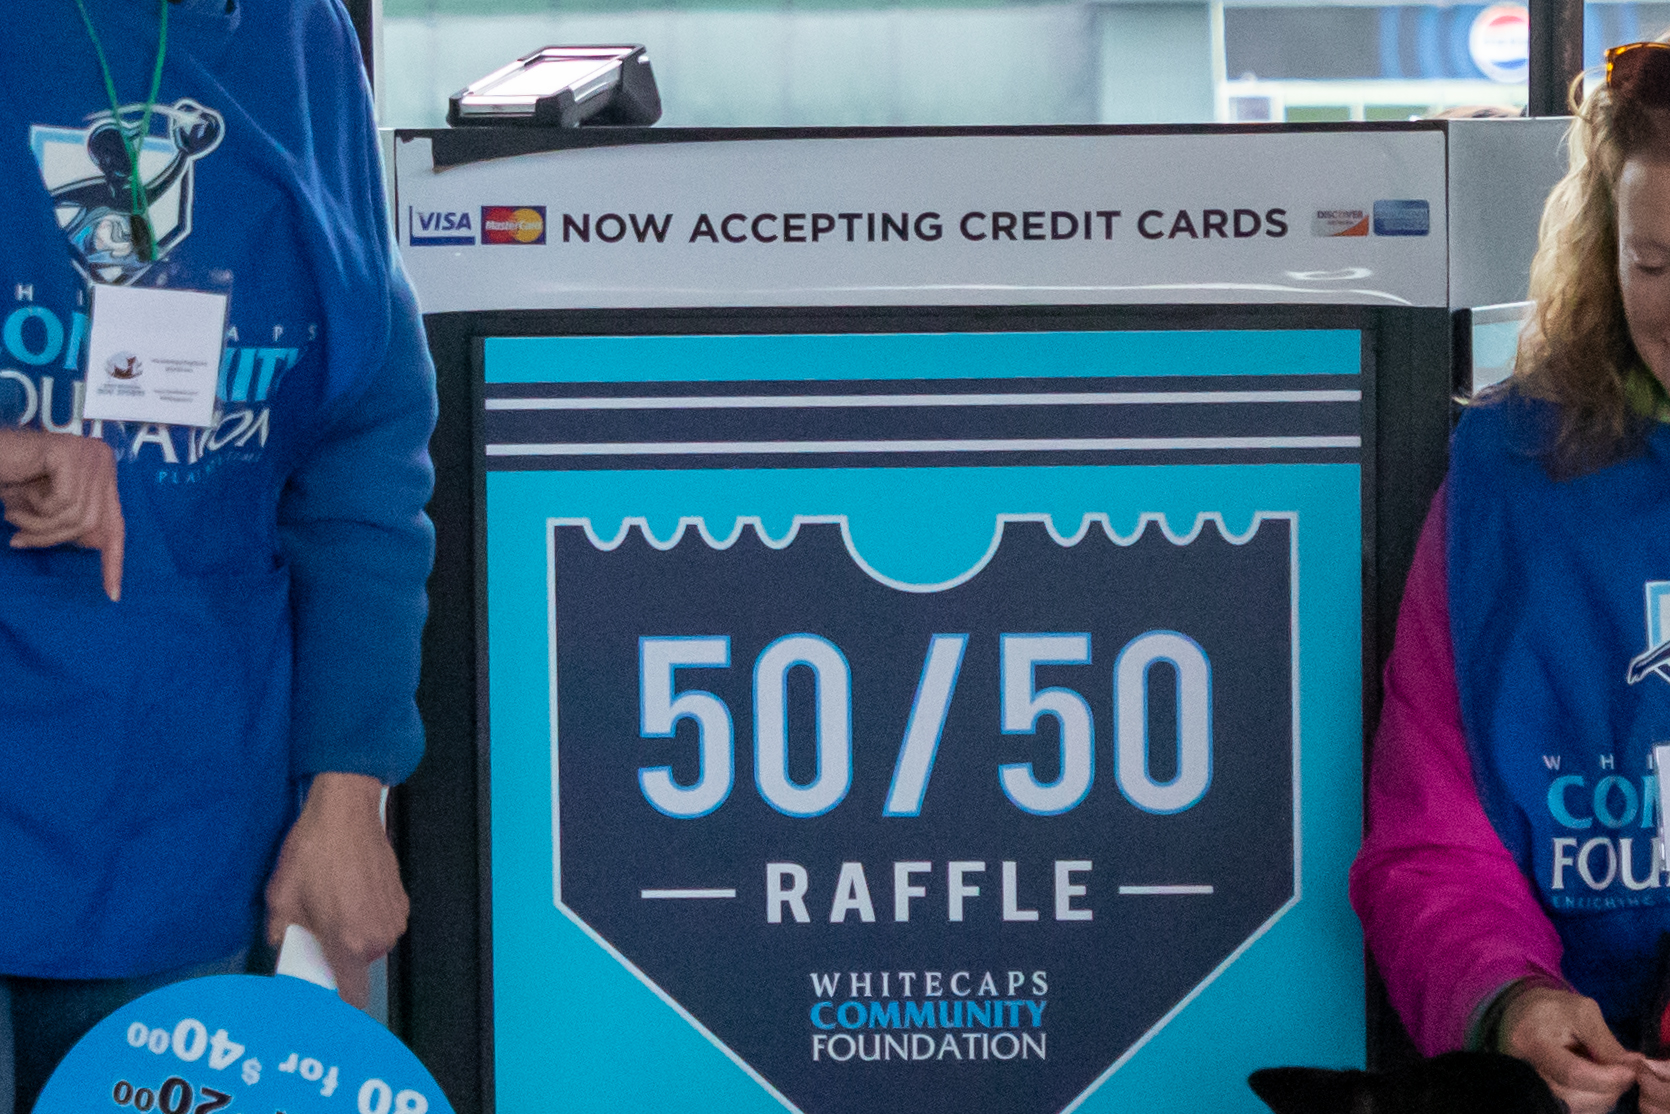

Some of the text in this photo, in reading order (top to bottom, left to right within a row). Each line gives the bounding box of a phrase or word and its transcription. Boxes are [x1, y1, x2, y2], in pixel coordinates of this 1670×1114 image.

[417, 211, 472, 231] VISA
[485, 219, 543, 232] MasterCard
[563, 207, 1289, 244] NOW ACCEPTING CREDIT CARDS
[1316, 209, 1364, 220] DISCOVER
[638, 628, 1214, 820] 50/50
[765, 860, 1094, 924] RAFFLE
[809, 970, 1049, 998] WHITECAPS
[809, 999, 1048, 1030] COMMUNITY
[811, 1032, 1048, 1062] FOUNDATION
[278, 1052, 339, 1097] for
